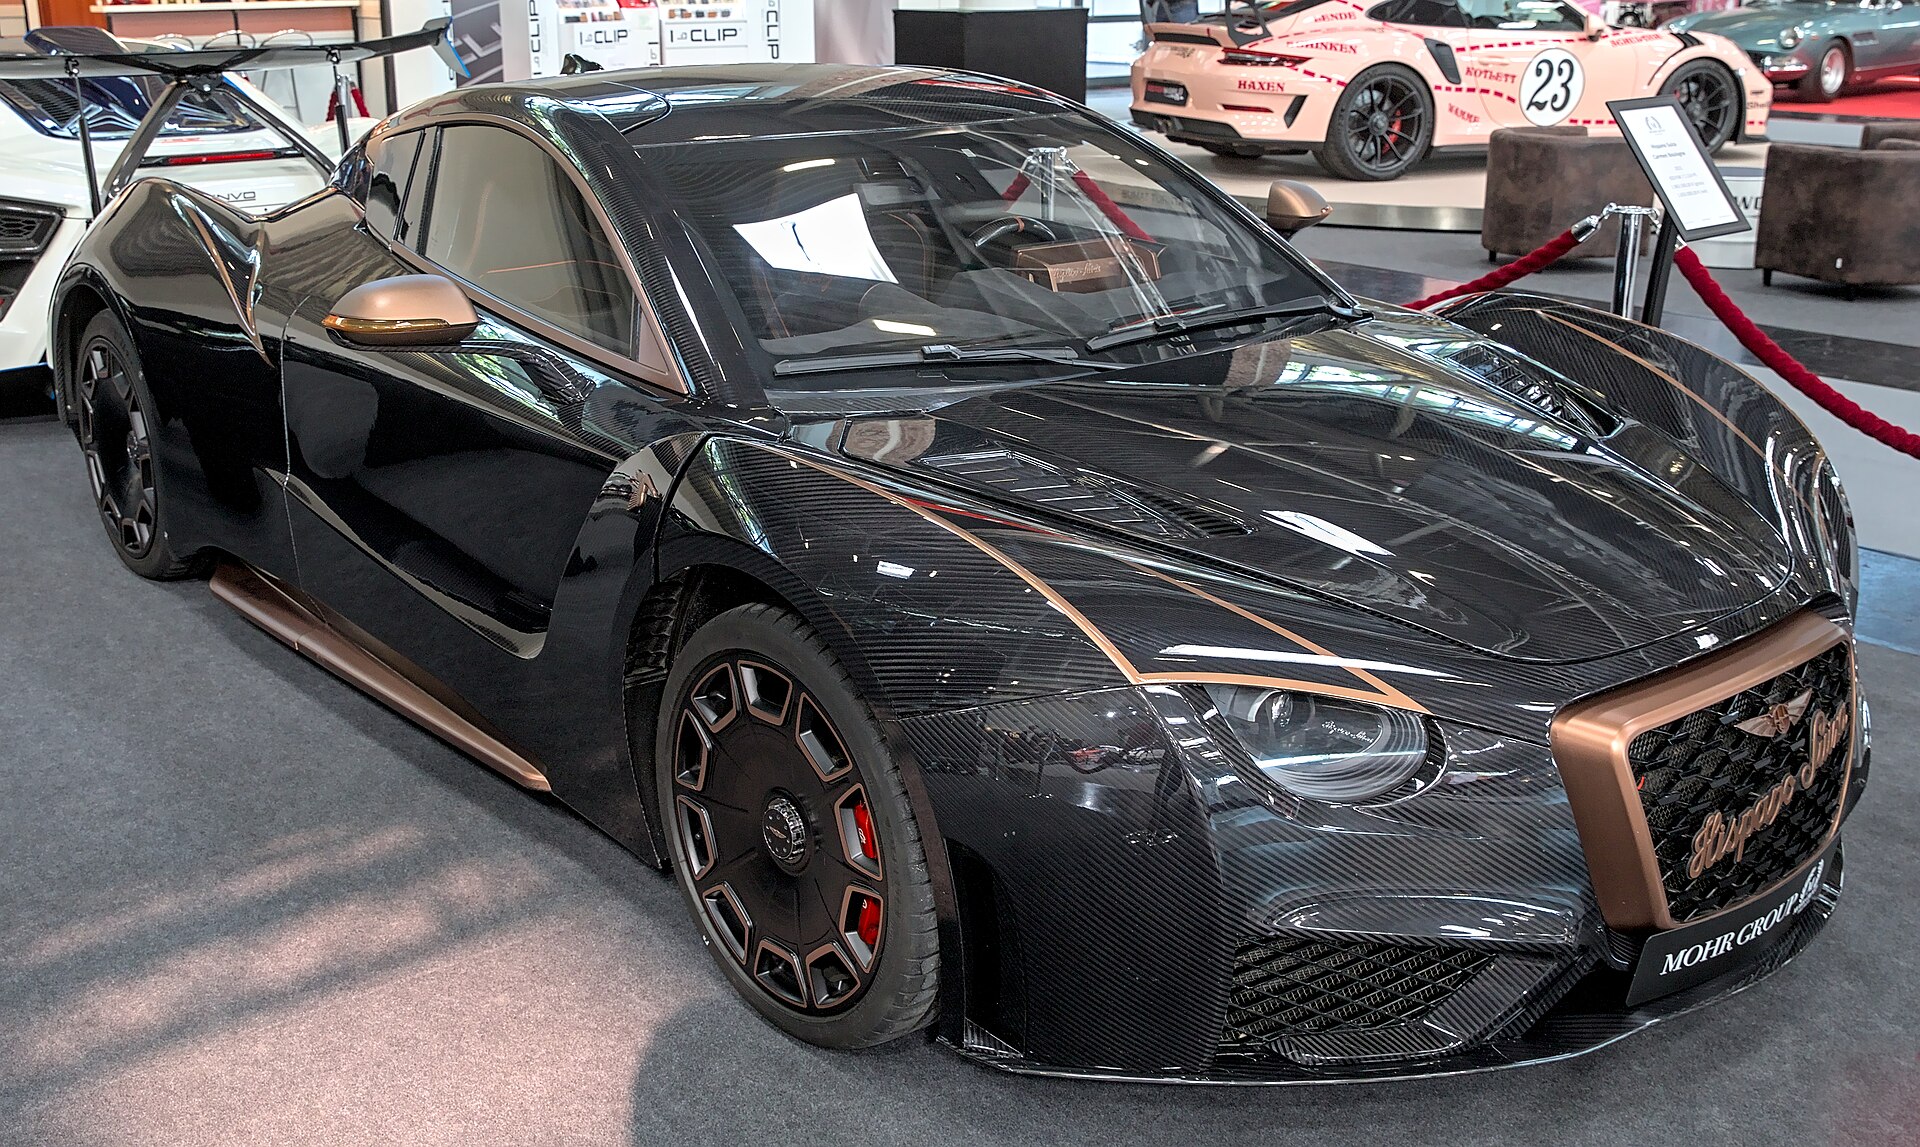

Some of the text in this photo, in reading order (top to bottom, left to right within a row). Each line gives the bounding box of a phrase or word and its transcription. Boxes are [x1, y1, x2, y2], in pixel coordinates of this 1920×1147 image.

[594, 29, 628, 44] CLIP
[690, 28, 738, 42] CLIP
[766, 10, 780, 59] CLIP
[1238, 80, 1285, 92] HAXEN
[1526, 58, 1574, 112] 23
[1659, 892, 1799, 976] MOHR GROUP
